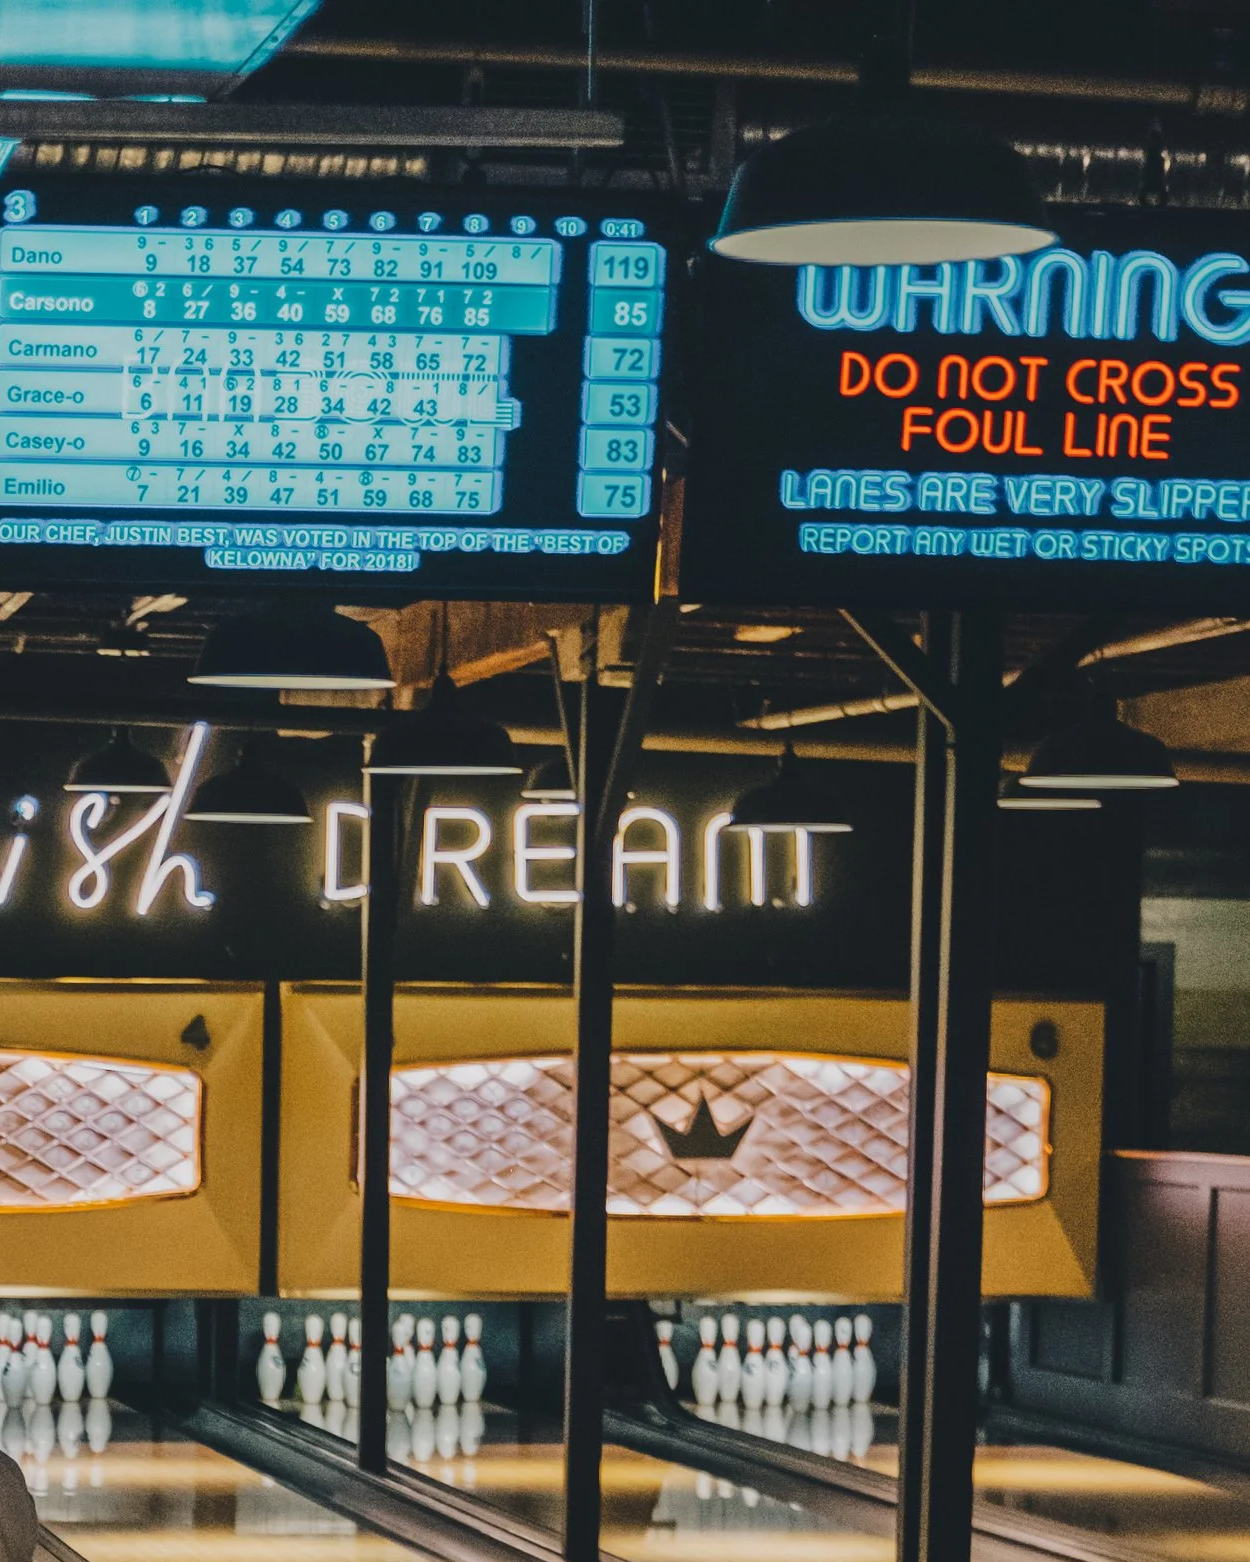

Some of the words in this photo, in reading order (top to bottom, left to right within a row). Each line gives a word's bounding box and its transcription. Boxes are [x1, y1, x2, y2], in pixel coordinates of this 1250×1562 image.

[8, 196, 26, 220] 3
[141, 211, 148, 223] 1
[188, 211, 197, 223] 2
[235, 212, 244, 224] 3
[282, 213, 291, 225] 4
[329, 215, 339, 228] 5
[376, 216, 386, 229] 6
[423, 217, 431, 230] 7
[470, 218, 480, 231] 8
[517, 219, 526, 232] 9
[560, 221, 577, 234] 10
[607, 222, 637, 236] 0:41
[137, 236, 147, 249] 9
[185, 237, 194, 250] 3
[205, 237, 214, 250] 6
[232, 238, 241, 251] 5
[278, 239, 288, 252] 9
[325, 241, 335, 254] 7
[372, 242, 382, 255] 9
[419, 243, 428, 256] 9
[465, 244, 475, 257] 5
[511, 245, 521, 258] 8
[11, 247, 63, 265] Dano
[145, 254, 157, 272] 9
[188, 255, 211, 272] 18
[233, 256, 257, 274] 37
[280, 257, 305, 275] 54
[327, 258, 351, 276] 73
[374, 260, 397, 277] 82
[420, 261, 443, 278] 91
[461, 262, 498, 280] 109
[603, 256, 649, 280] 119
[9, 292, 94, 312] Carsono
[143, 300, 156, 318] 8
[183, 301, 210, 319] 27
[230, 302, 256, 320] 36
[277, 303, 303, 321] 40
[324, 305, 350, 323] 59
[371, 306, 396, 324] 68
[417, 307, 443, 325] 76
[464, 308, 490, 326] 85
[613, 302, 648, 326] 85
[156, 283, 166, 296] 2
[182, 284, 193, 297] 6
[229, 285, 239, 298] 9
[276, 286, 286, 299] 4
[332, 289, 343, 300] X
[370, 289, 379, 301] 7
[390, 289, 400, 302] 2
[417, 289, 426, 302] 7
[437, 290, 444, 303] 1
[463, 291, 472, 303] 7
[482, 291, 492, 304] 2
[798, 250, 1250, 345] WARNING
[134, 329, 143, 342] 6
[182, 330, 190, 342] 7
[228, 331, 237, 344] 9
[275, 332, 284, 345] 3
[294, 332, 304, 345] 6
[321, 334, 331, 347] 2
[341, 334, 350, 347] 7
[368, 335, 377, 347] 4
[388, 335, 397, 348] 3
[415, 336, 424, 349] 7
[462, 337, 471, 349] 7
[8, 340, 98, 358] Carmano
[136, 347, 160, 364] 17
[182, 348, 207, 366] 24
[229, 349, 254, 366] 33
[276, 350, 300, 368] 42
[323, 351, 345, 368] 51
[369, 352, 393, 369] 58
[416, 353, 440, 370] 65
[463, 354, 486, 372] 72
[612, 349, 644, 372] 72
[838, 350, 920, 399] DO
[936, 353, 1049, 403] NOT
[1065, 357, 1241, 409] CROSS
[7, 386, 84, 407] Grace-o
[140, 393, 152, 411] 6
[182, 394, 204, 412] 11
[228, 395, 252, 413] 19
[274, 396, 298, 414] 28
[321, 397, 345, 415] 34
[366, 398, 391, 415] 42
[413, 399, 438, 417] 43
[609, 394, 641, 417] 53
[130, 423, 140, 434] 6
[151, 423, 160, 435] 3
[178, 423, 187, 435] 7
[234, 424, 244, 436] X
[270, 425, 280, 437] 8
[900, 406, 1044, 456] FOUL
[1062, 410, 1173, 461] LINE
[5, 432, 85, 453] Casey-o
[138, 439, 150, 457] 9
[180, 440, 204, 458] 16
[225, 440, 250, 459] 34
[272, 441, 296, 460] 42
[318, 443, 343, 460] 50
[365, 444, 389, 461] 67
[412, 445, 436, 462] 74
[457, 446, 482, 463] 83
[606, 439, 638, 462] 83
[4, 478, 66, 496] Emilio
[136, 484, 149, 502] 7
[177, 485, 200, 503] 21
[223, 486, 248, 504] 39
[270, 487, 295, 505] 47
[316, 489, 339, 506] 51
[363, 489, 387, 507] 59
[409, 490, 433, 508] 68
[455, 491, 480, 509] 75
[604, 485, 636, 508] 75
[783, 472, 909, 510] LANES
[919, 475, 995, 512] ARE
[1006, 479, 1103, 515] VERY
[45, 525, 100, 546] CHEF,
[104, 526, 171, 543] JUSTIN
[177, 528, 230, 548] BEST,
[233, 529, 278, 546] WAS
[282, 528, 346, 547] VOTED
[352, 531, 370, 548] IN
[375, 531, 413, 548] THE
[419, 532, 458, 549] TOP
[461, 534, 488, 550] OF
[492, 534, 529, 550] THE
[598, 536, 627, 553] OF
[802, 527, 907, 554] REPORT
[915, 530, 963, 555] ANY
[970, 531, 1027, 558] WET
[1035, 534, 1074, 559] OR
[1082, 536, 1168, 561] STICKY
[320, 553, 360, 569] FOR
[365, 553, 413, 570] 2018!
[322, 800, 814, 910] DREAM
